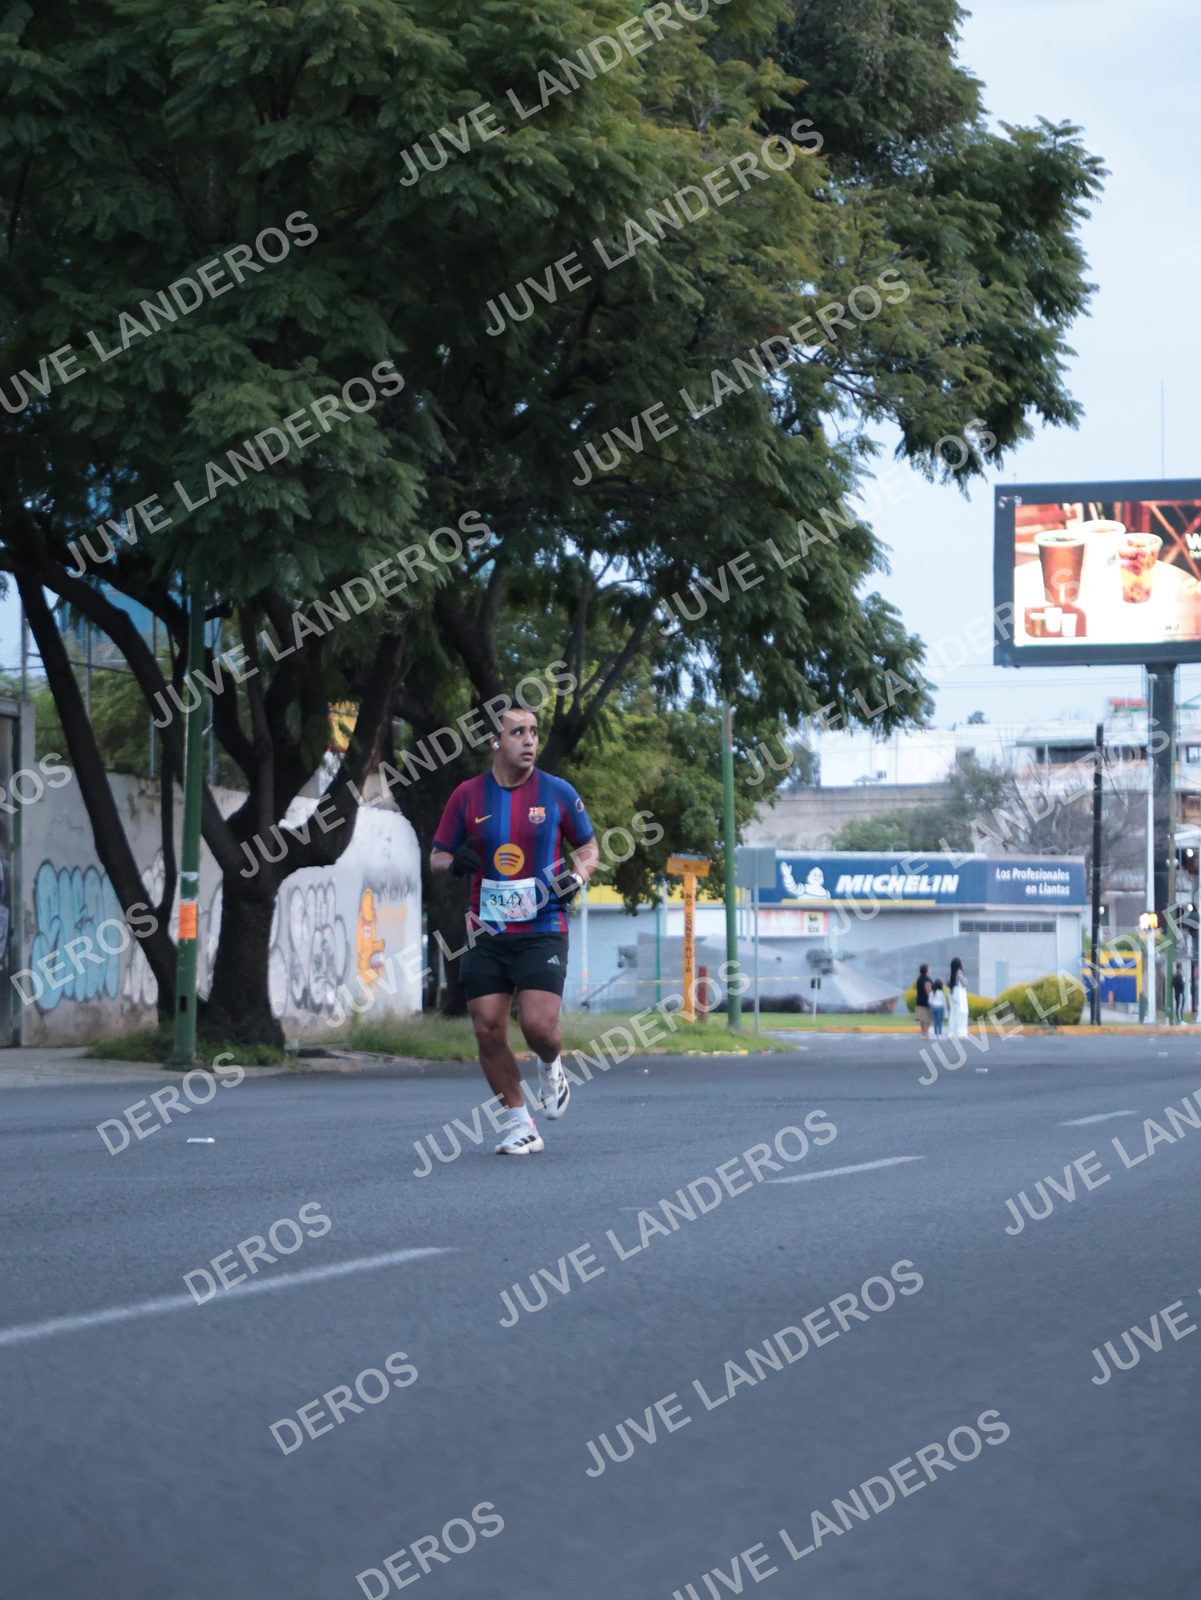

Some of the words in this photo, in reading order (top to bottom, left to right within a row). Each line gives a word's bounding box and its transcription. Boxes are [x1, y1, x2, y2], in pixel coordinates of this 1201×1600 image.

[996, 867, 1011, 880] Los
[1012, 867, 1070, 881] Profesionales
[835, 875, 959, 894] MICHELIN
[1025, 884, 1037, 895] en
[1038, 882, 1070, 896] Llantas
